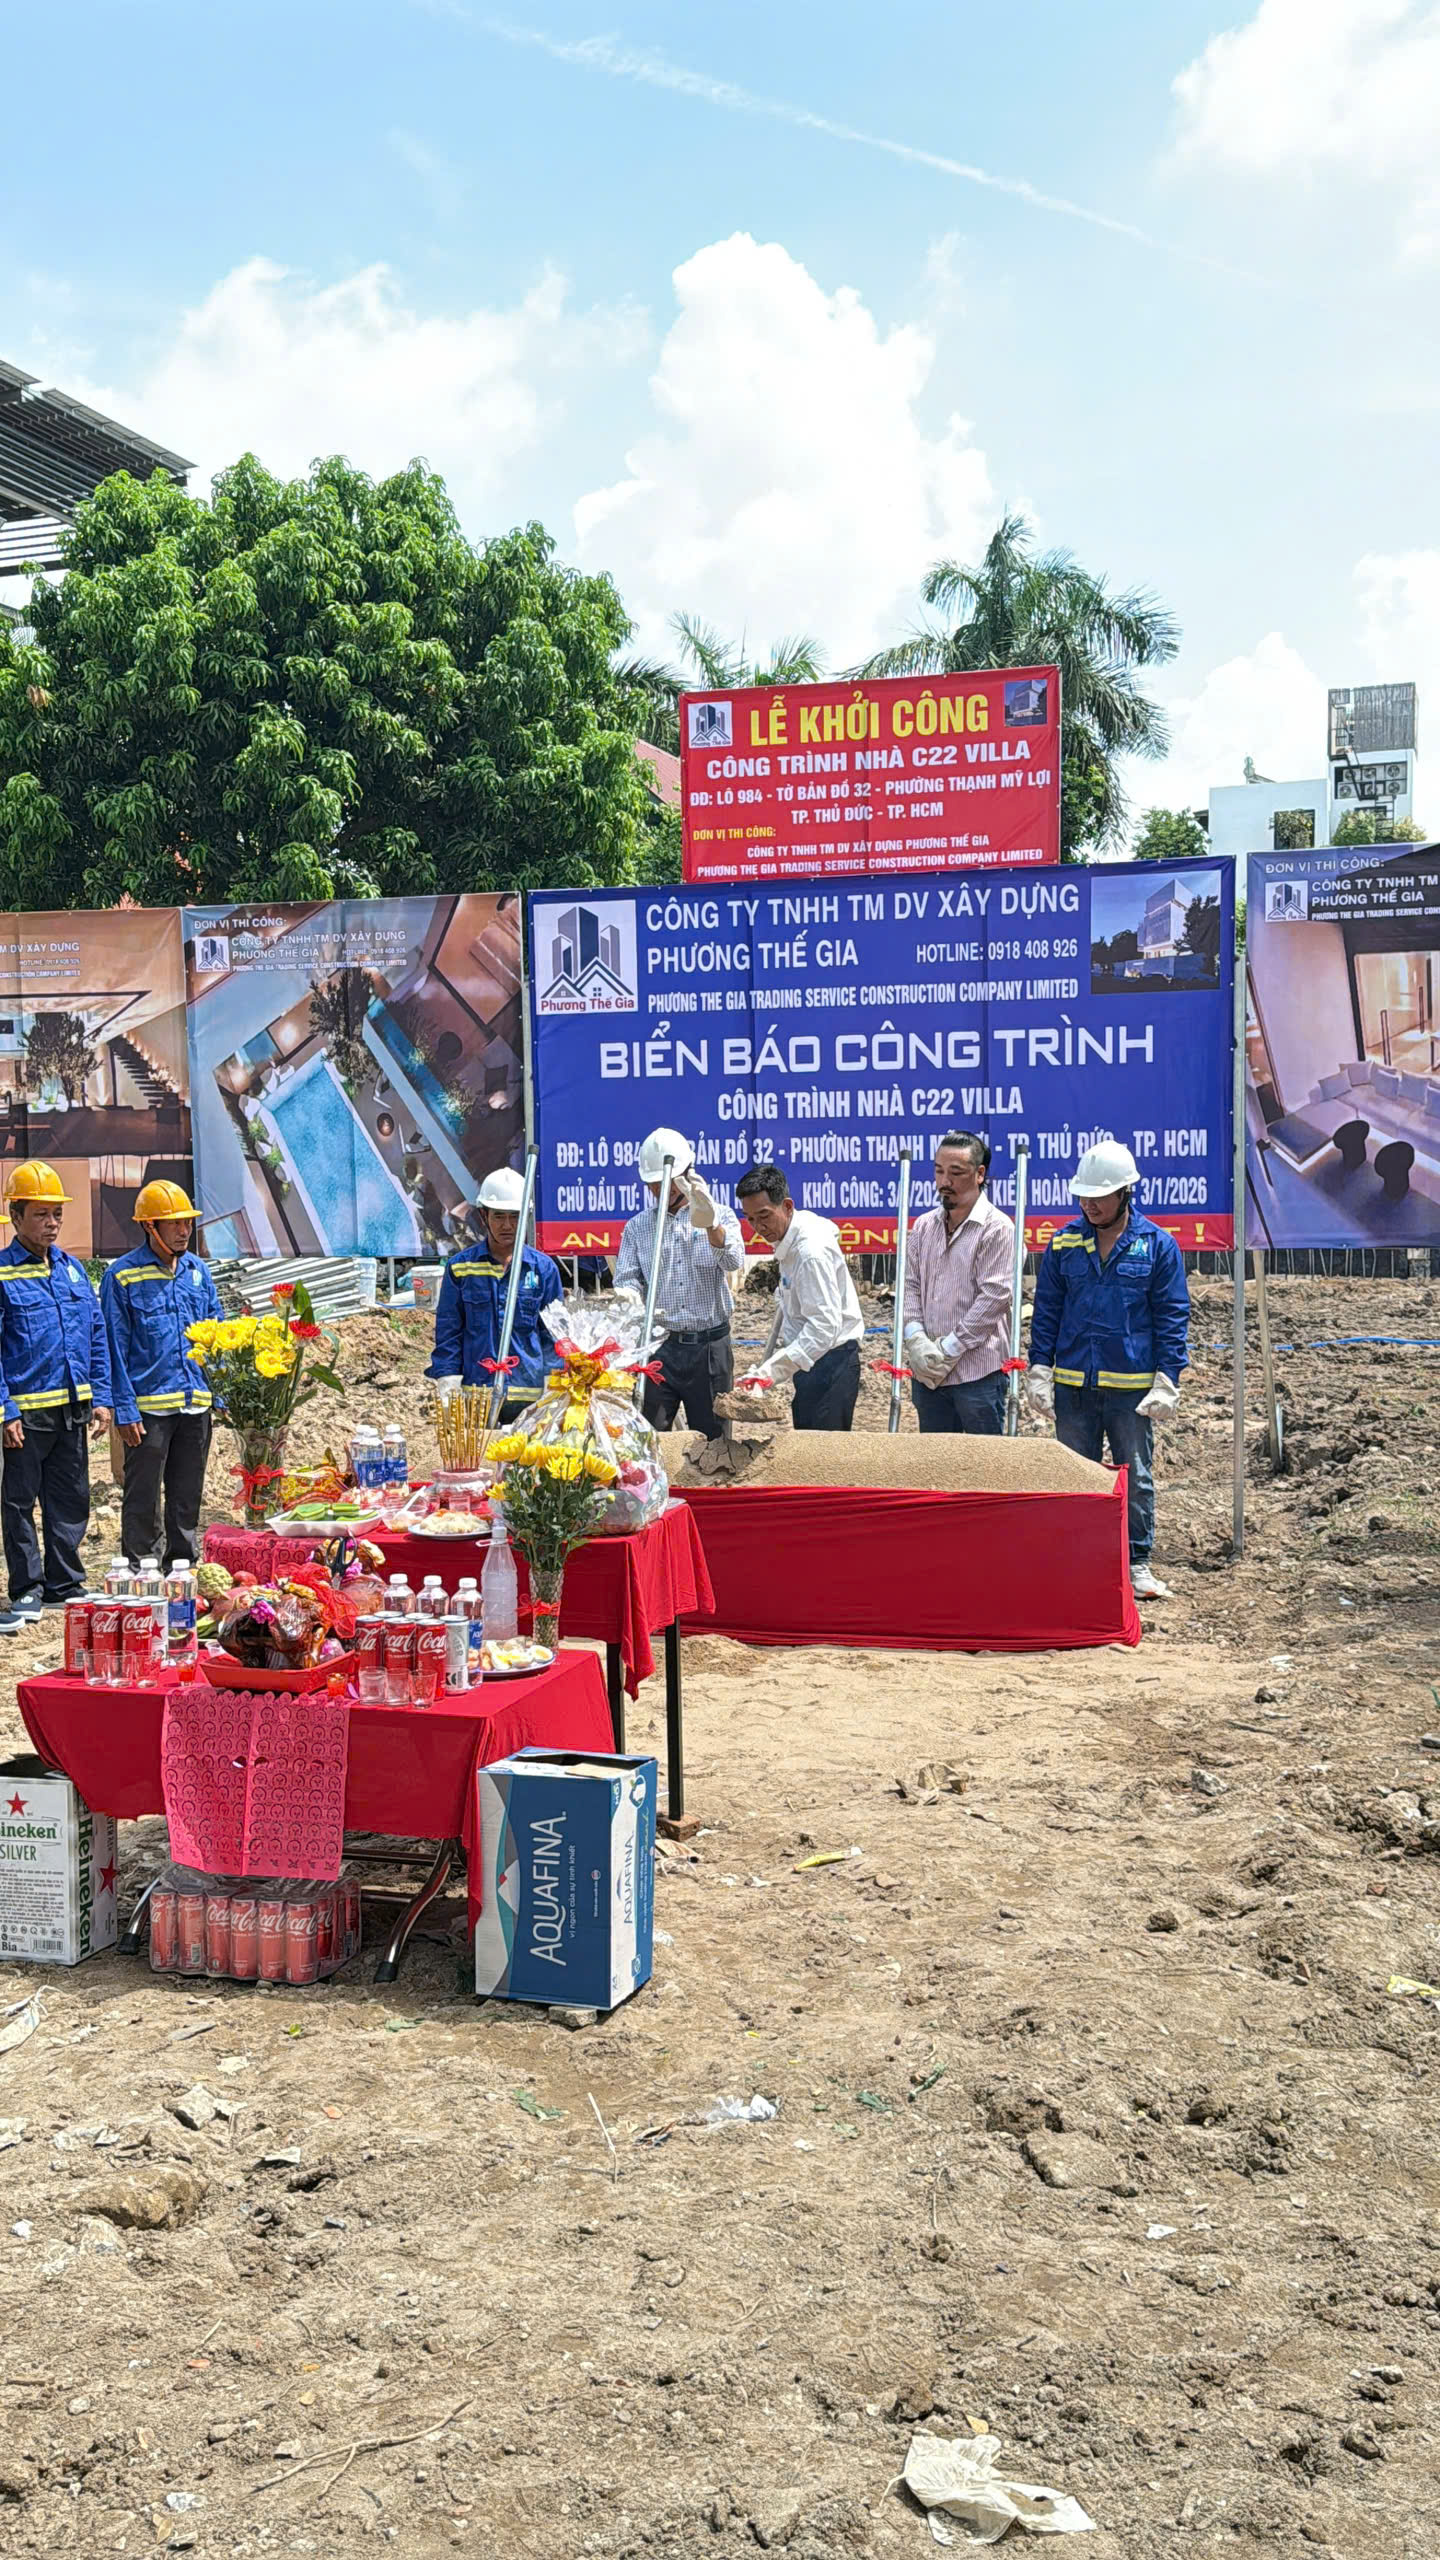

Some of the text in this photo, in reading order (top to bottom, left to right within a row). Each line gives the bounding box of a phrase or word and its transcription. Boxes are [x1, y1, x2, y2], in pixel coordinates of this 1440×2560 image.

[751, 690, 989, 746] LỄ KHỞI CÔNG
[707, 740, 1031, 779] CÔNG TRÌNH NHÀ C22 VILLA
[717, 787, 734, 805] LÔ
[738, 789, 763, 804] 984
[776, 784, 794, 801] TỜ
[798, 782, 827, 800] BẢN
[854, 783, 871, 797] 32
[885, 776, 945, 795] PHƯỜNG
[948, 774, 996, 793] THẠNH
[1001, 769, 1023, 787] MỸ
[1028, 769, 1051, 788] LỢI
[791, 810, 810, 824] TP.
[814, 803, 841, 823] THỦ
[845, 804, 873, 822] ĐỨC
[888, 805, 906, 819] TP.
[911, 802, 944, 817] HCM
[716, 828, 726, 841] VỊ
[728, 828, 744, 839] THI
[746, 825, 776, 838] CÔNG:
[747, 833, 990, 858] CÔNG TY TNHH TM DV XÂY DỰNG PHƯƠNG THẾ GIA
[740, 863, 758, 875] THE
[760, 863, 777, 874] GIA
[780, 861, 822, 873] TRADING
[825, 859, 865, 871] SERVICE
[869, 855, 946, 869] CONSTRUCTION
[948, 852, 999, 866] COMPANY
[1001, 849, 1043, 862] LIMITED
[1266, 856, 1385, 874] ĐƠN VỊ THI CÔNG:
[1312, 875, 1439, 891] CÔNG TY TNHH TM
[646, 882, 1080, 931] CÔNG TY TNHH TM DV XÂY DỰNG
[1312, 888, 1425, 907] PHƯƠNG THẾ GIA
[194, 916, 287, 930] ĐƠN VỊ THI CÔNG:
[266, 936, 279, 945] TY
[282, 935, 311, 945] TNHH
[314, 934, 330, 943] TM
[332, 933, 347, 943] DV
[350, 931, 372, 942] XÂY
[375, 931, 406, 942] DỰNG
[916, 938, 1078, 963] HOTLINE: 0918 408 926
[302, 948, 320, 958] GIA
[647, 930, 859, 974] PHƯƠNG THẾ GIA
[541, 996, 635, 1012] Phương Thế Gia
[648, 978, 1078, 1014] PHƯƠNG THE GIA TRADING SERVICE CONSTRUCTION COMPANY LIMITED
[600, 1014, 1154, 1078] BIỂN BÁO CÔNG TRÌNH
[718, 1083, 1024, 1121] CÔNG TRÌNH NHÀ C22 VILLA
[557, 1142, 584, 1168] ĐĐ:
[589, 1136, 609, 1167] LÔ
[753, 1138, 774, 1164] 32
[790, 1130, 861, 1163] PHƯỜNG
[1037, 1123, 1072, 1159] THỦ
[1133, 1130, 1158, 1157] TP.
[1164, 1128, 1207, 1156] HCM
[557, 1177, 585, 1212] CHỦ
[619, 1182, 640, 1211] TƯ:
[803, 1173, 836, 1208] KHỞI
[840, 1175, 883, 1208] CÔNG:
[1140, 1176, 1208, 1205] 3/1/2026
[561, 1232, 610, 1248] AN
[0, 1822, 57, 1839] ineken
[0, 1843, 37, 1861] SILVER
[78, 1815, 94, 1957] Heineken
[529, 1814, 568, 1967] AQUAFINA
[623, 1832, 635, 1925] AQUAFINA
